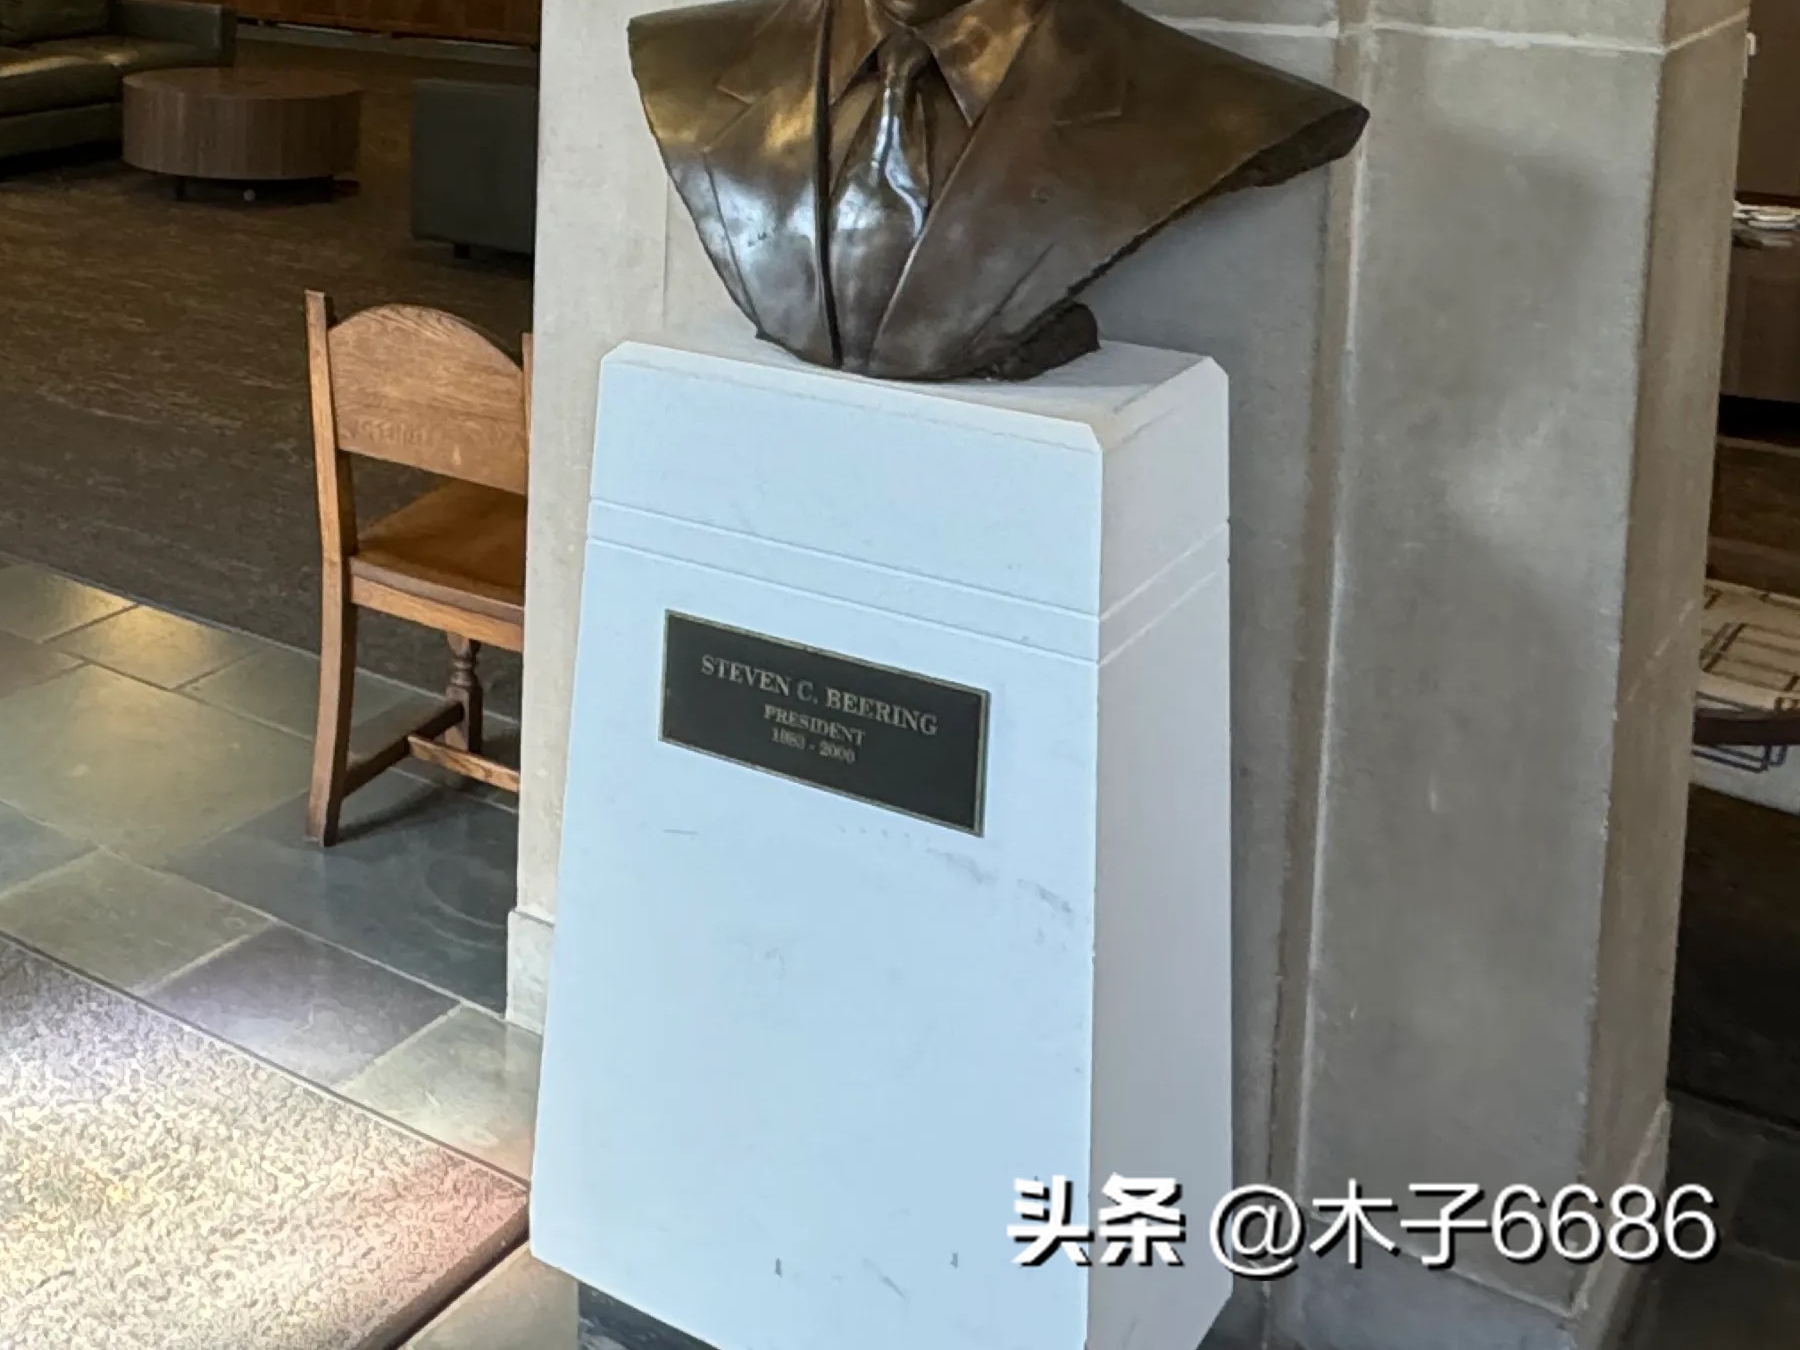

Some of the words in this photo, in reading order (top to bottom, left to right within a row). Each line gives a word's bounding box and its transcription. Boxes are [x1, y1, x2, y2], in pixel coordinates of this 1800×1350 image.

[701, 654, 792, 696] STEVEN
[797, 680, 818, 704] C.
[825, 686, 938, 735] BEERING
[763, 703, 866, 746] PRESIDENT
